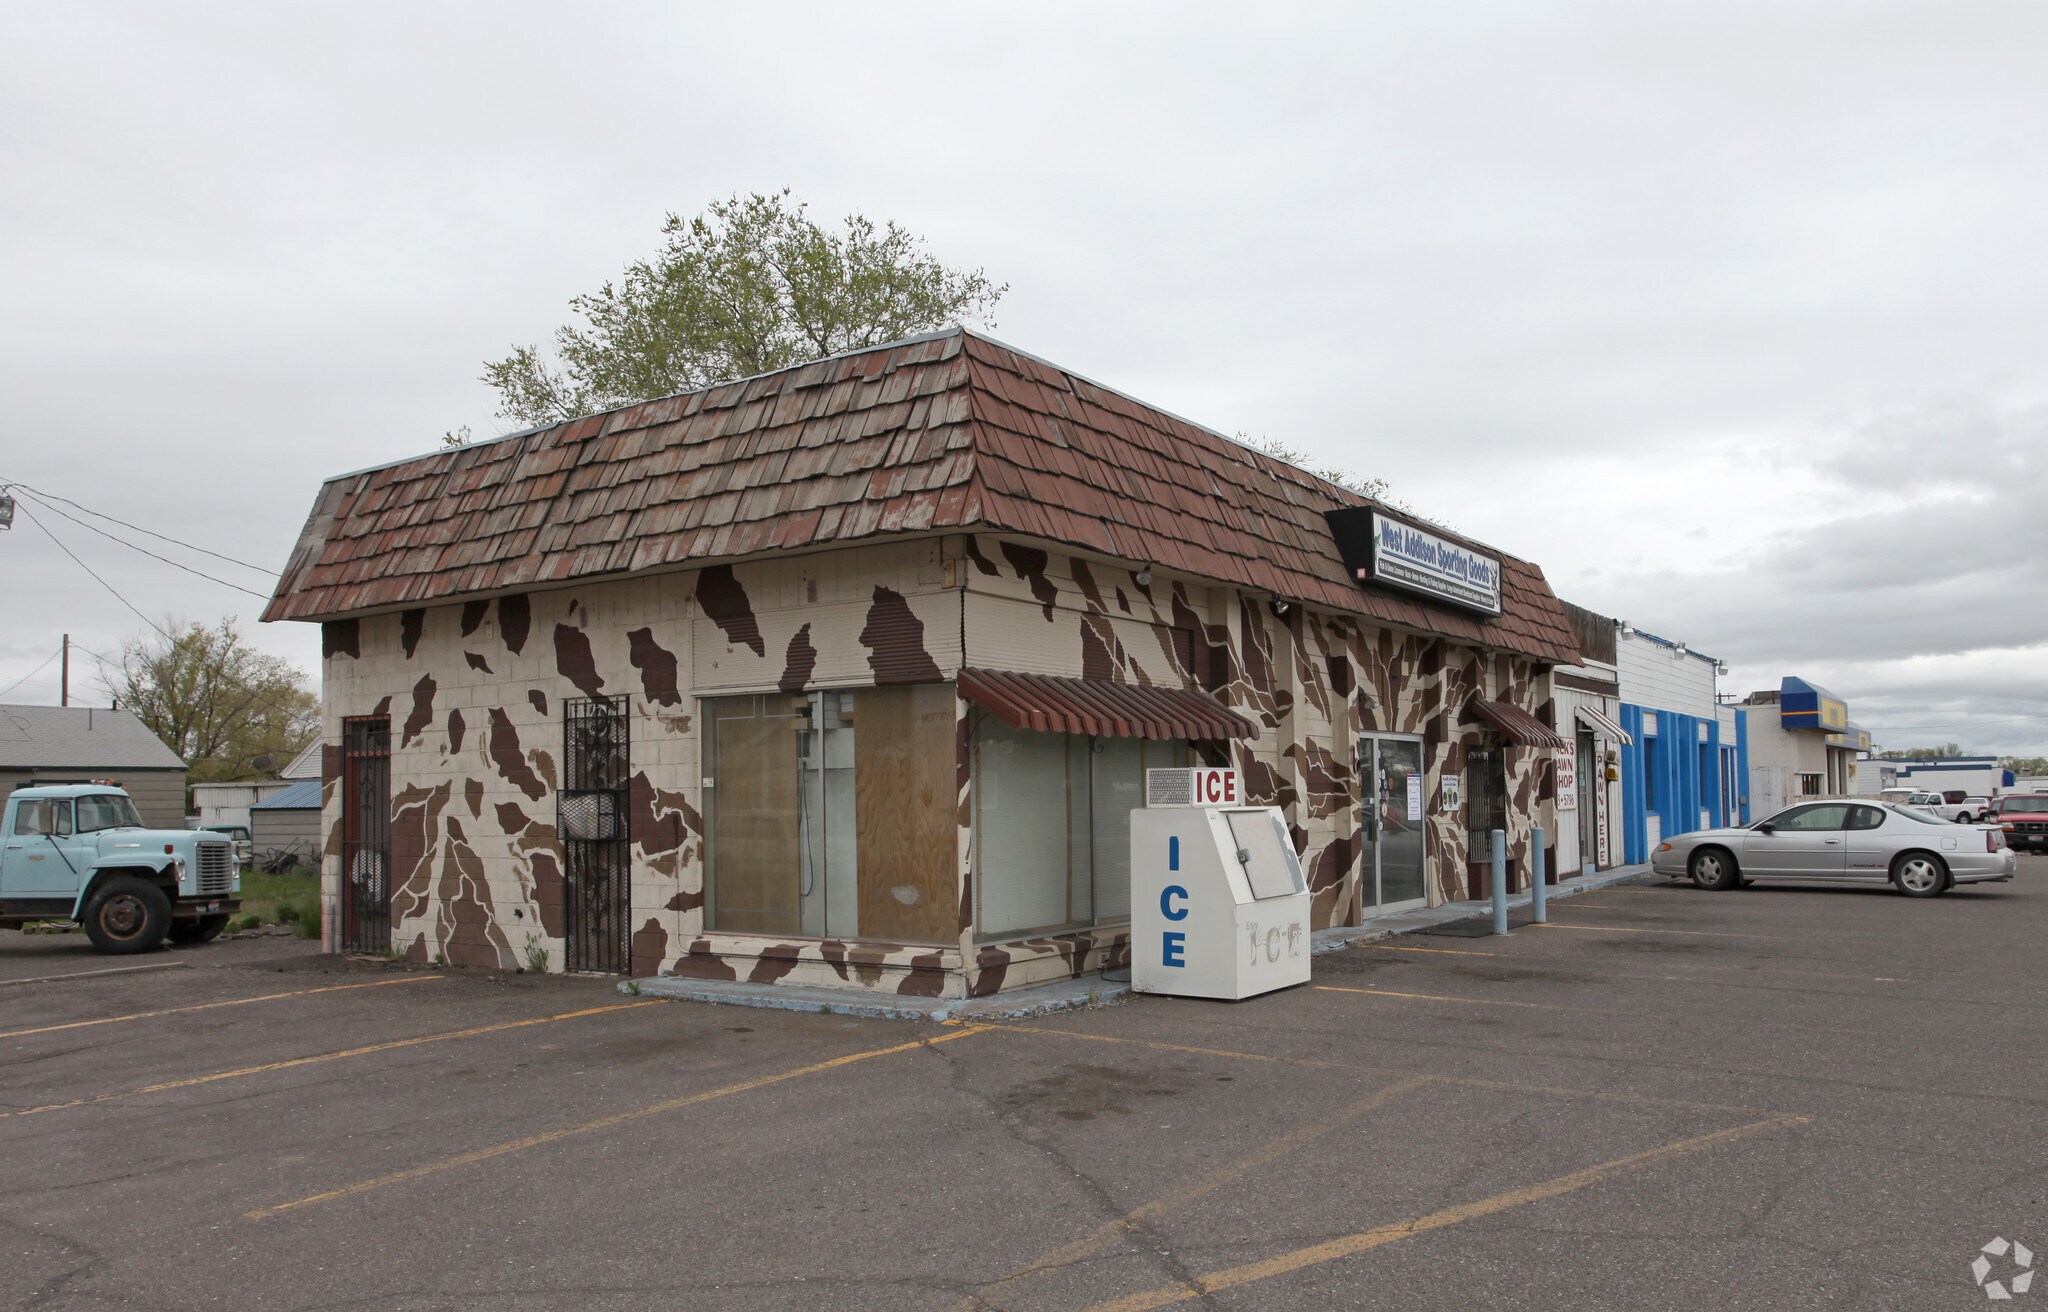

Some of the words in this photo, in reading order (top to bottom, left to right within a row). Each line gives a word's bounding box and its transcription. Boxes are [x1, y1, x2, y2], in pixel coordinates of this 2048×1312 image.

[1381, 519, 1403, 553] West
[1404, 529, 1436, 565] Addison
[1437, 541, 1468, 582] Sporting
[1468, 554, 1490, 584] Goods
[1196, 770, 1235, 803] ICE
[1598, 811, 1606, 862] HERE
[1160, 836, 1189, 968] ICE
